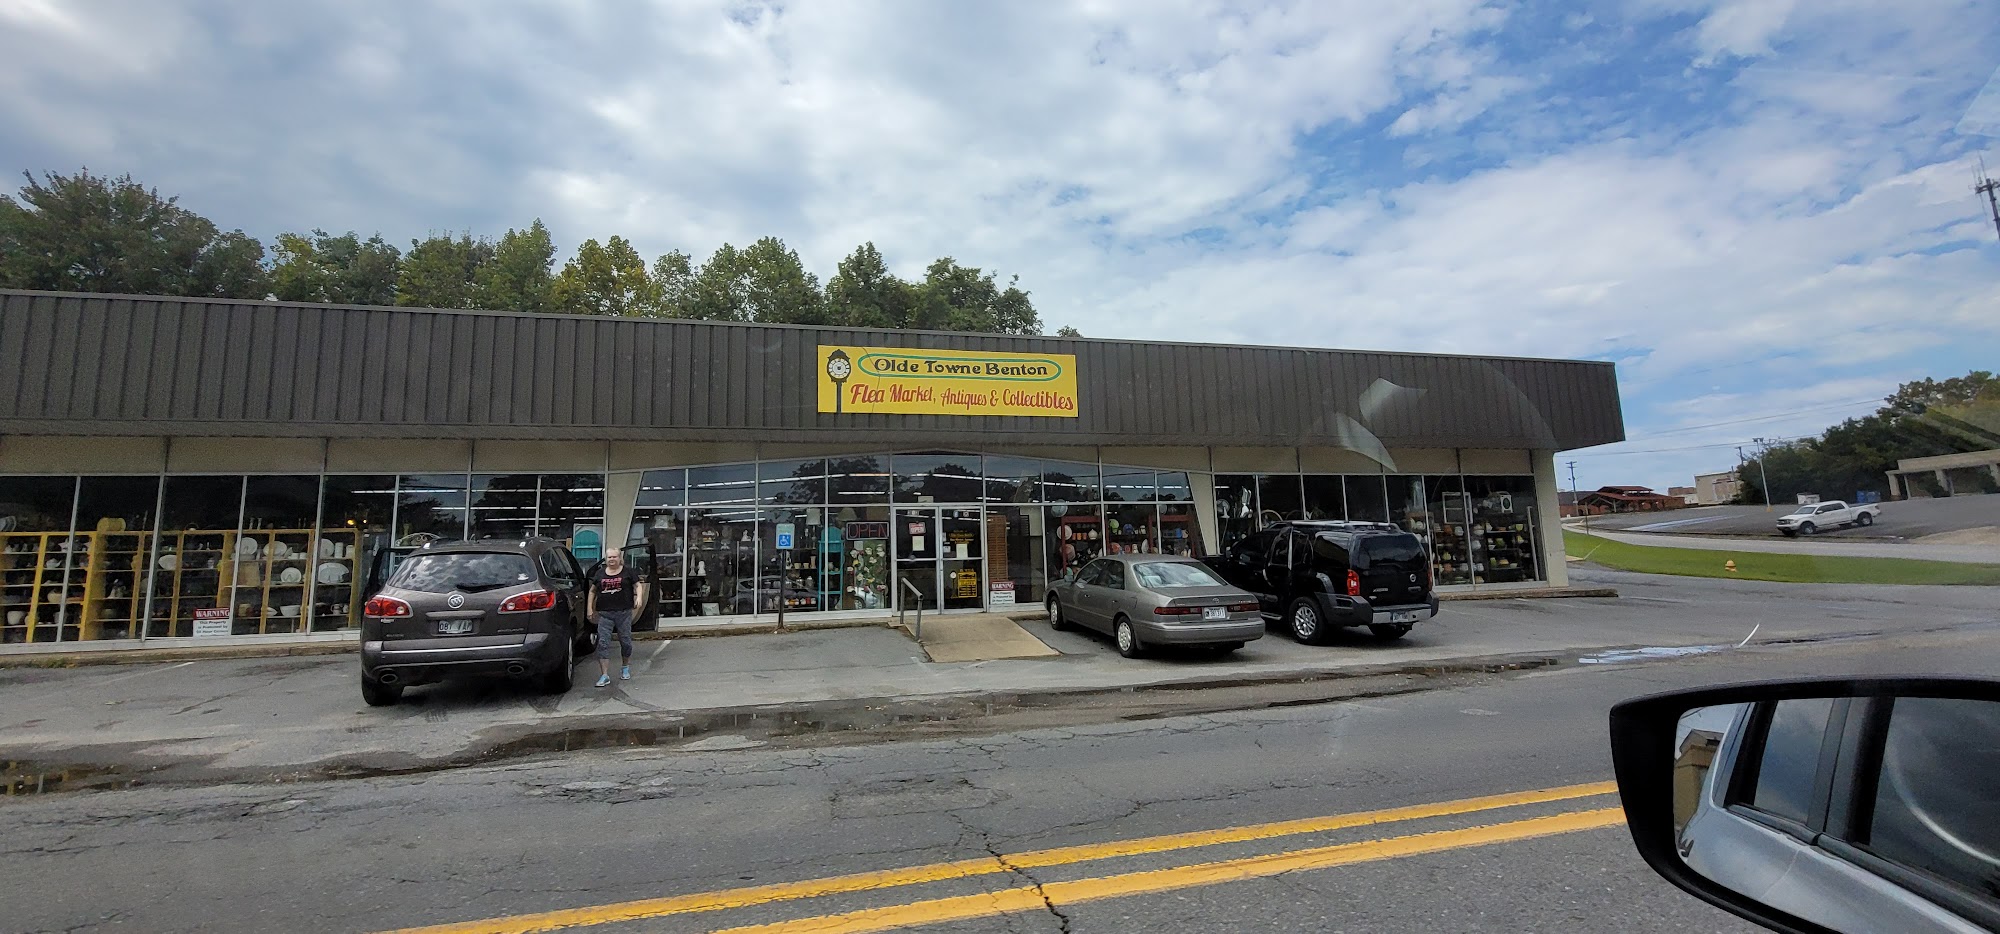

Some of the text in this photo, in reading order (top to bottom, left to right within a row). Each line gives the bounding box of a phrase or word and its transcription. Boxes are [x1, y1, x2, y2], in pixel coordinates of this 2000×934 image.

[874, 358, 1048, 376] Olde Towne Benton
[850, 383, 886, 405] Flea
[940, 387, 987, 411] Antiques
[990, 389, 999, 407] &
[1002, 388, 1074, 411] Collectibles
[848, 523, 888, 539] OPEN
[195, 610, 230, 618] WARNING
